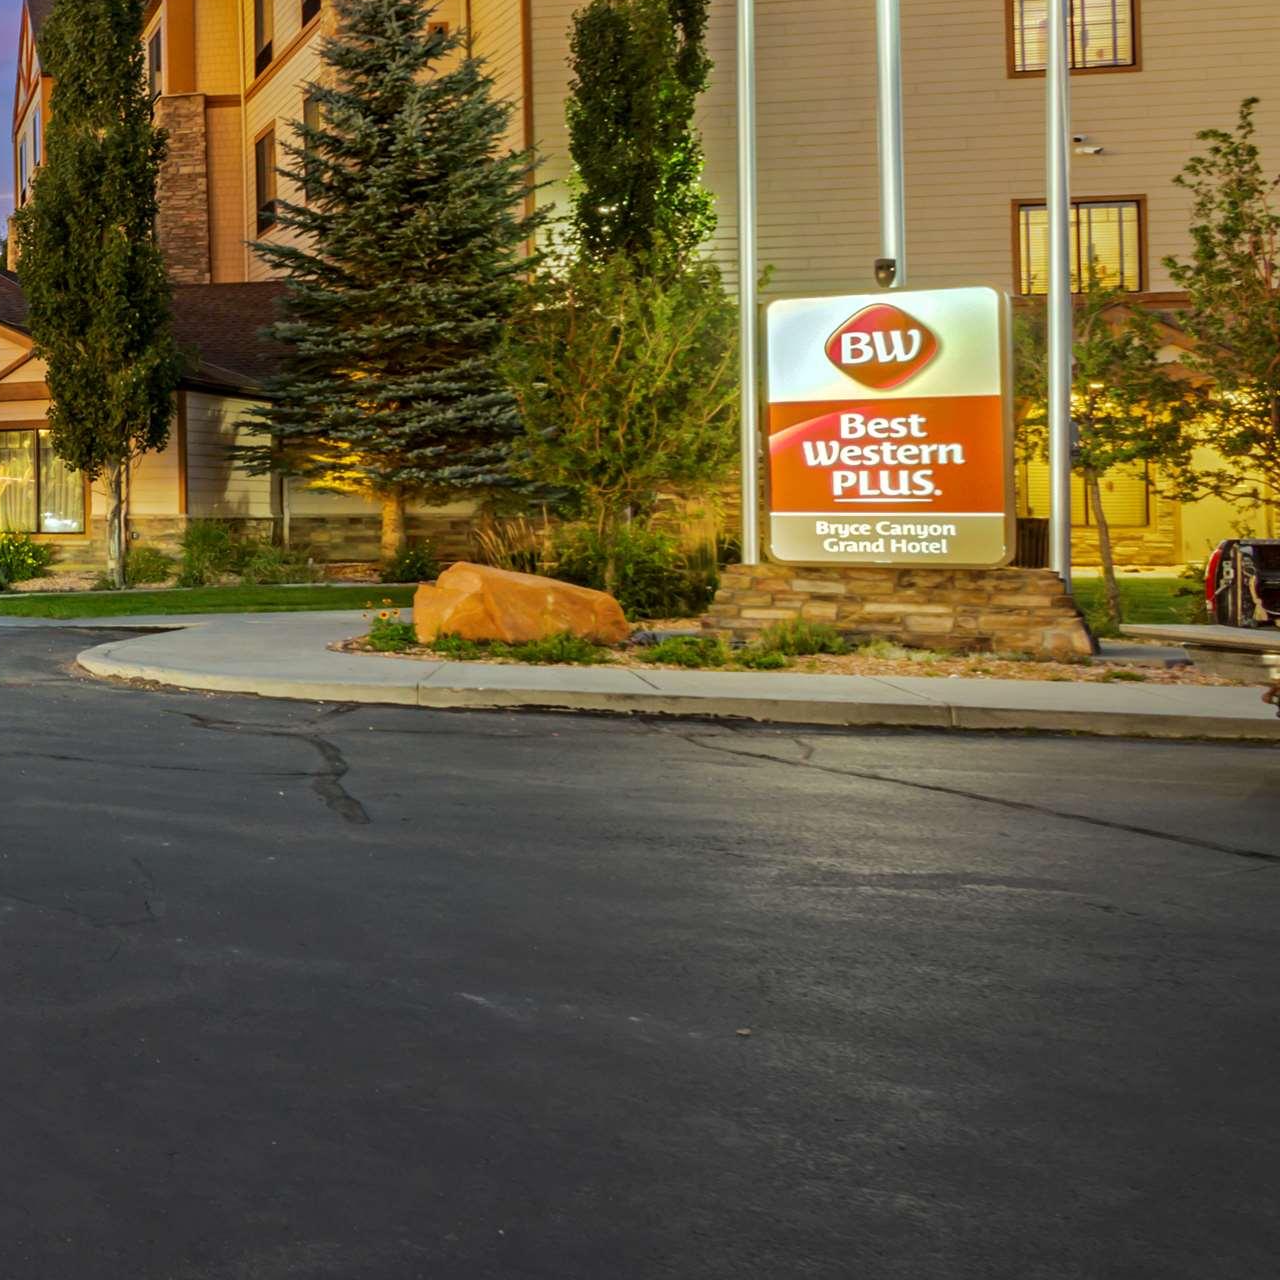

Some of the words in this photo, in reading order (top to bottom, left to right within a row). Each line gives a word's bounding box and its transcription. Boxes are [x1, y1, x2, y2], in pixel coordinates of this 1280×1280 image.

[841, 329, 922, 364] BW
[839, 413, 927, 439] Best
[802, 441, 965, 467] Western
[815, 521, 871, 538] Bryce
[875, 521, 956, 538] Canyon
[823, 538, 885, 553] Grand
[890, 538, 948, 554] Hotel
